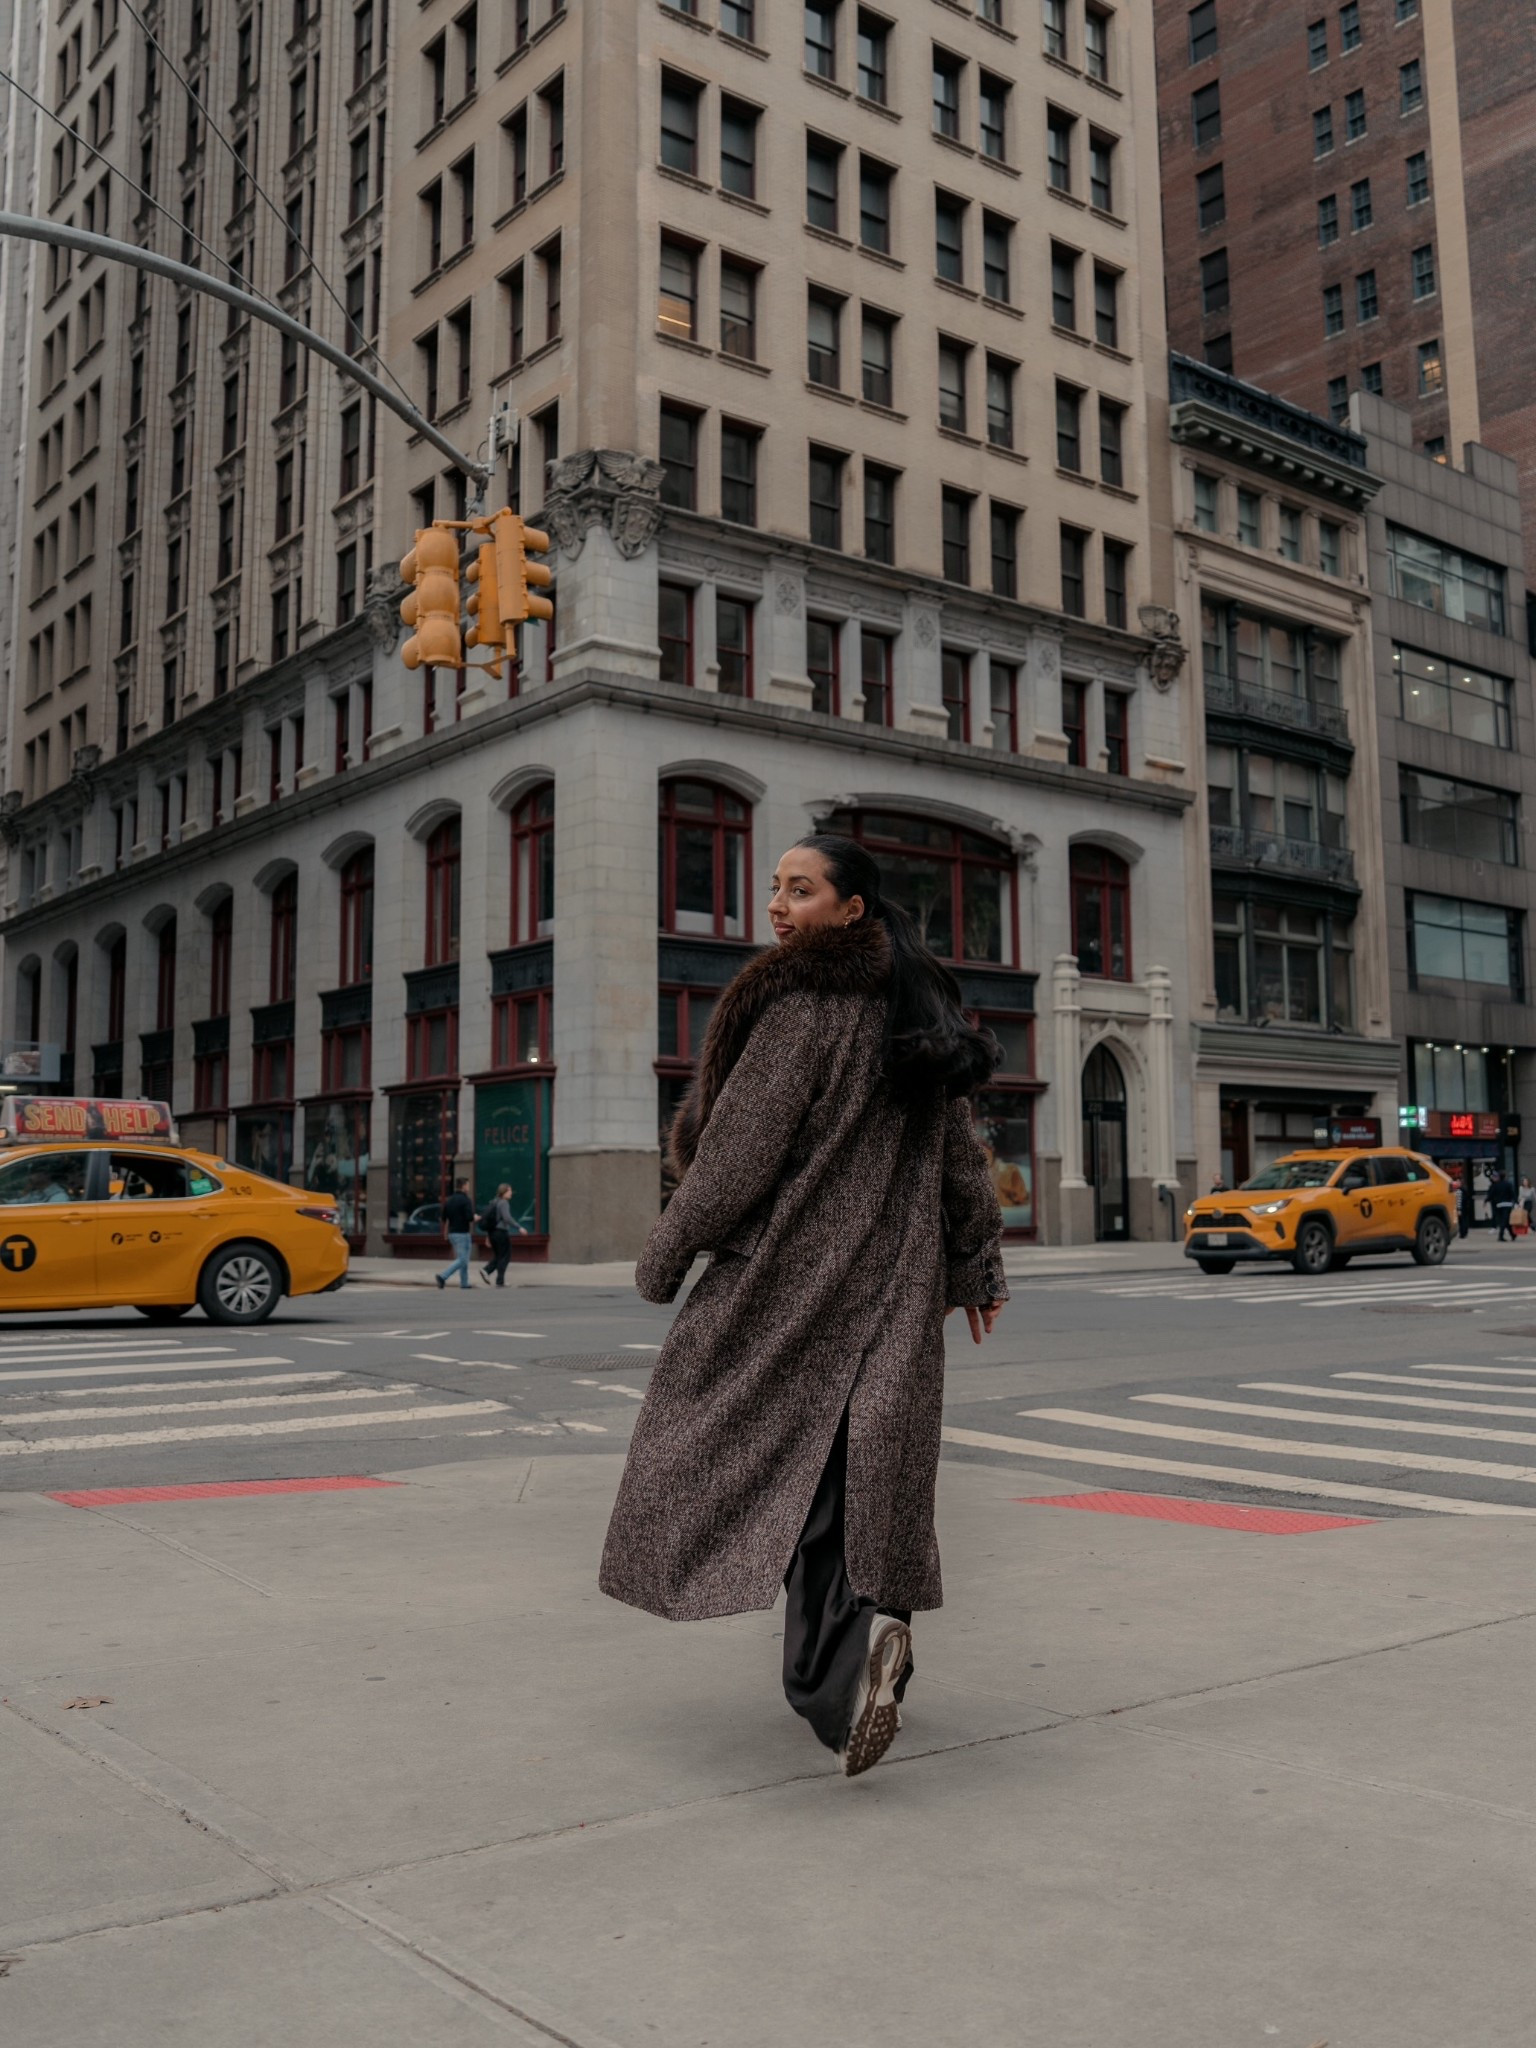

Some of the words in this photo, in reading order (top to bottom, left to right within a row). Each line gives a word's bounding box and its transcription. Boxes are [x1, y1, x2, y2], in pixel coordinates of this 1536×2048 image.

[24, 1104, 87, 1132] SEND
[103, 1106, 161, 1134] HELP
[484, 1124, 529, 1145] FELICE
[6, 1241, 29, 1268] T
